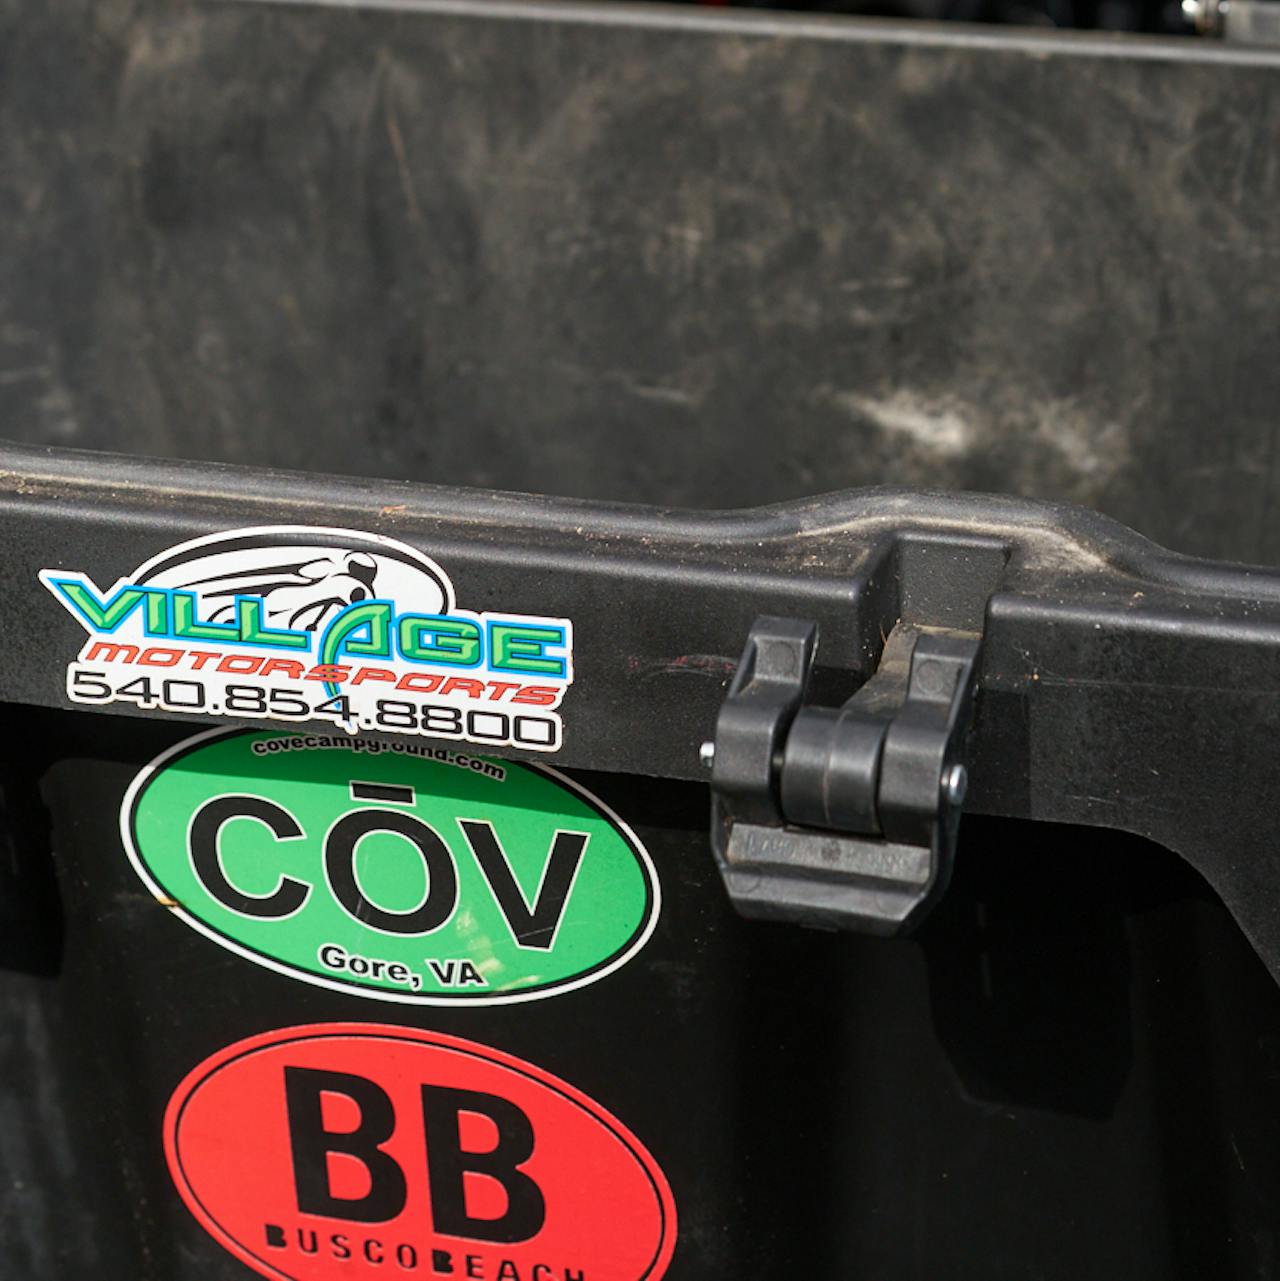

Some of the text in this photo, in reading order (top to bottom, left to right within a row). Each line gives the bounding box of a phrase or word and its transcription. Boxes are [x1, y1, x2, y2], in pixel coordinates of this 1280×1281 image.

[47, 577, 567, 680] VILLAGE
[73, 671, 556, 746] 540.854.8800
[86, 642, 560, 705] MOTORSPORTS
[320, 945, 487, 989] Gore, VA
[283, 1066, 547, 1245] BB
